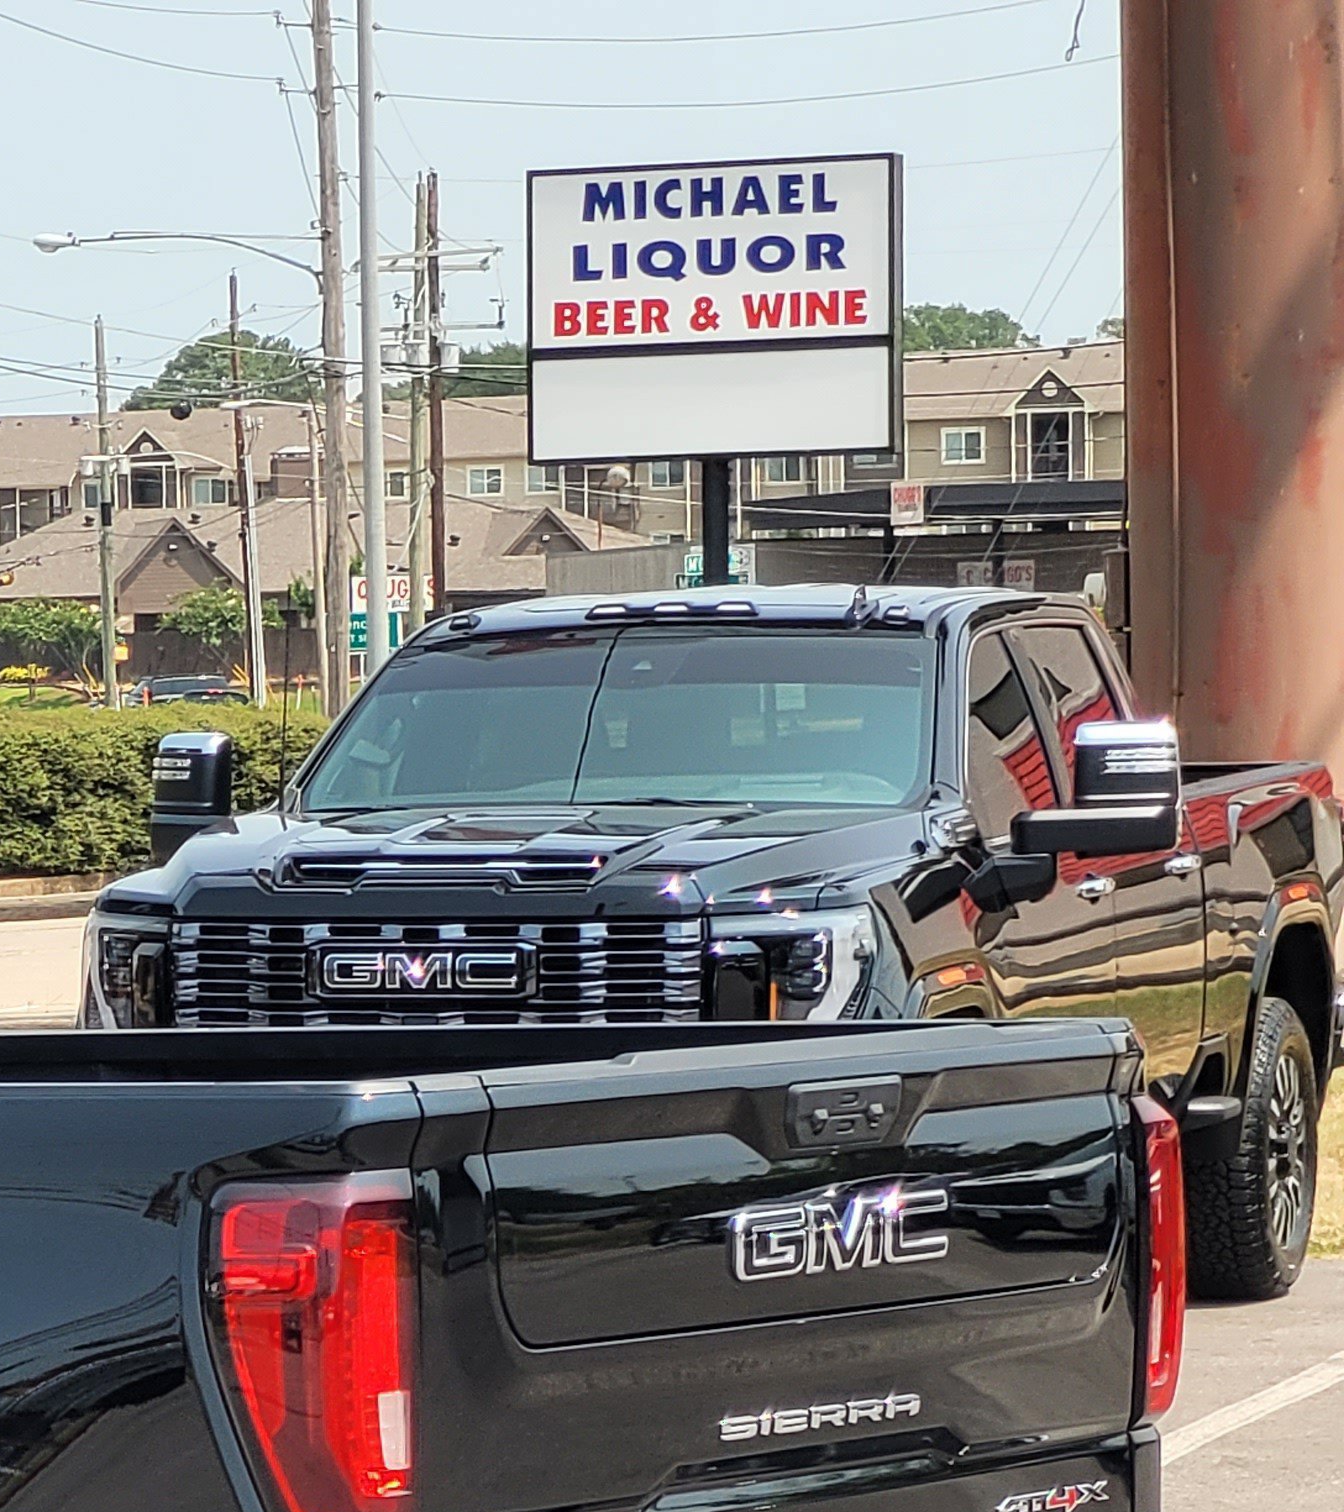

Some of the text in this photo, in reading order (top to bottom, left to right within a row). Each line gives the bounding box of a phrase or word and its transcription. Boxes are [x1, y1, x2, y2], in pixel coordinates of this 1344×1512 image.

[581, 172, 838, 222] MICHAEL
[572, 233, 847, 282] LIQUOR
[553, 289, 868, 337] BEER & WINE
[324, 952, 517, 989] GMC
[728, 1189, 950, 1281] GMC
[719, 1392, 921, 1442] SIERRA
